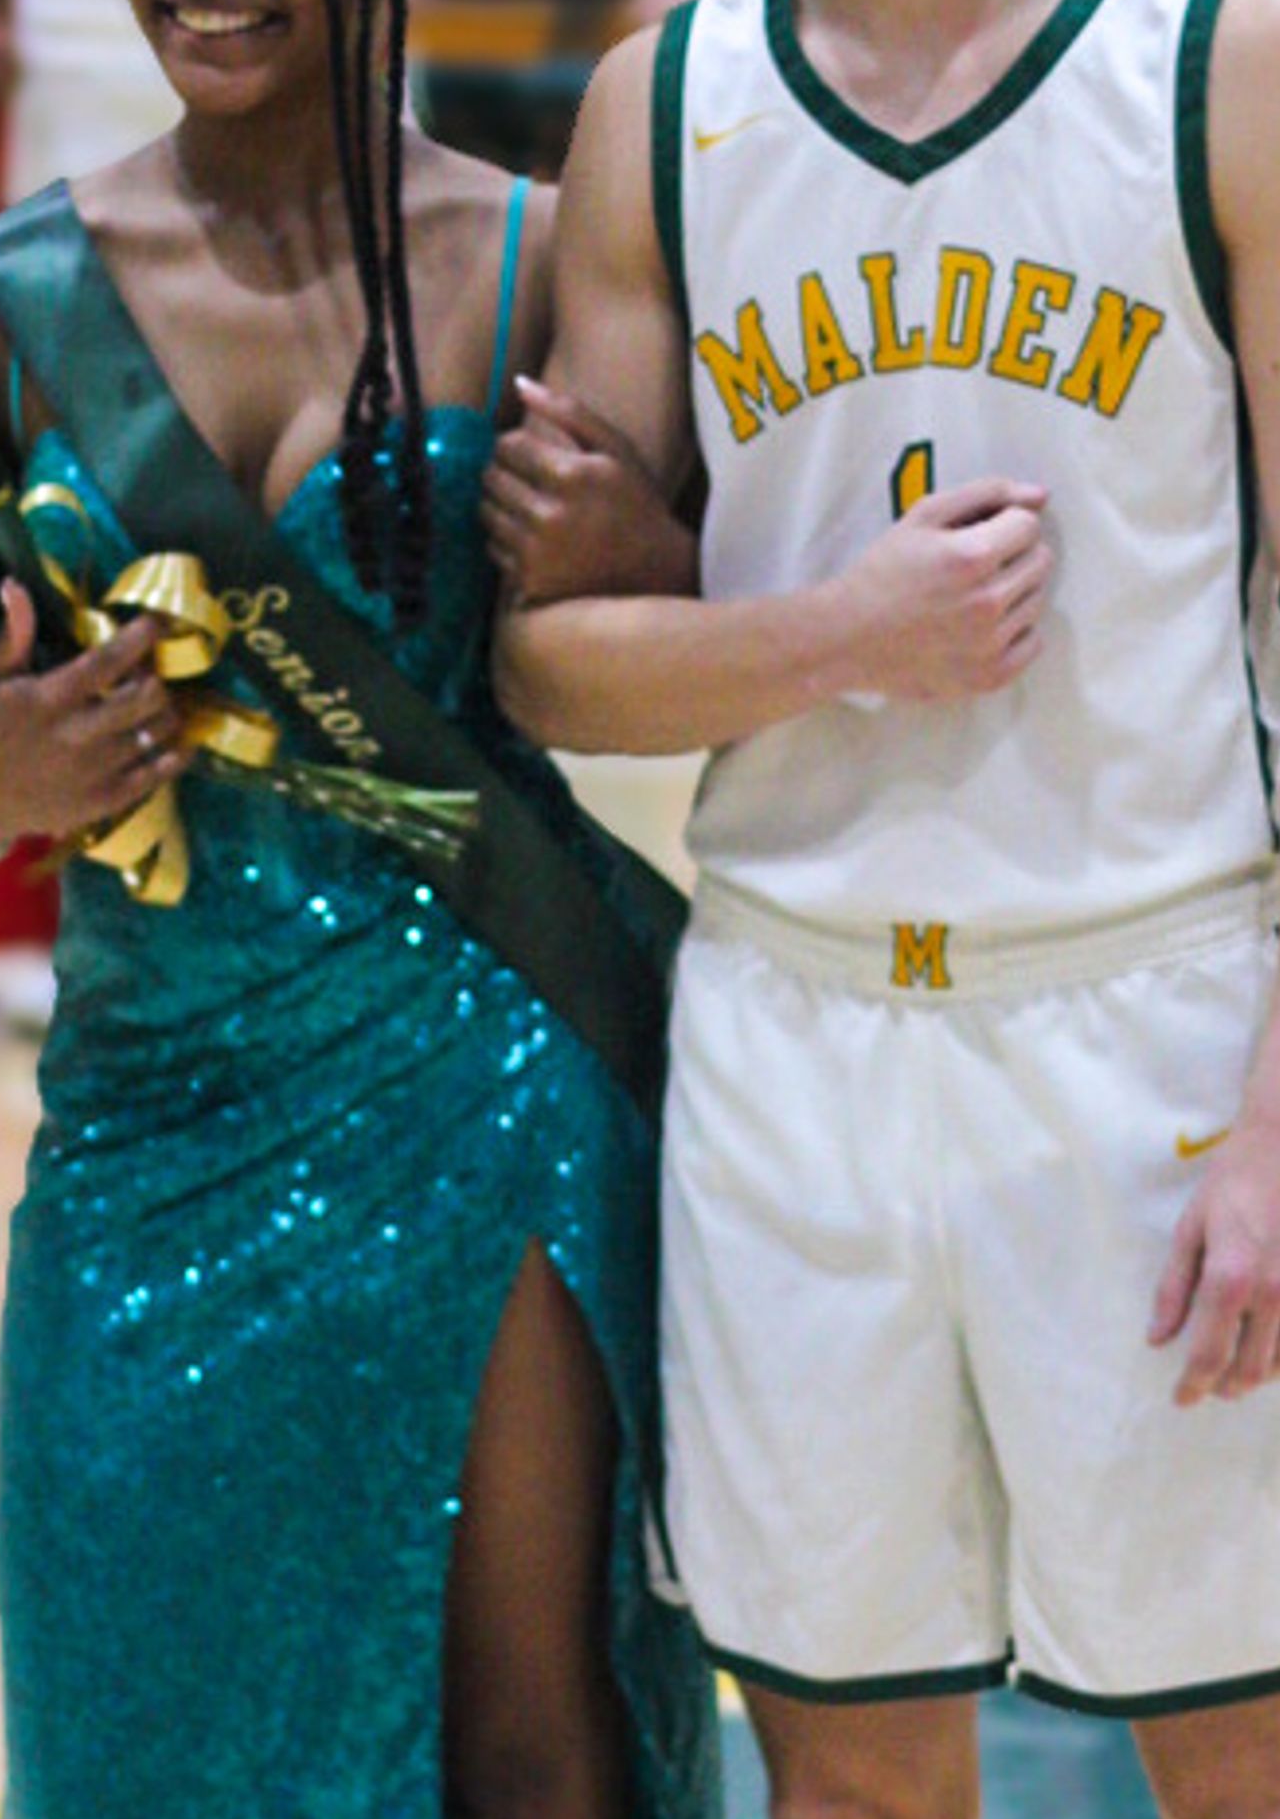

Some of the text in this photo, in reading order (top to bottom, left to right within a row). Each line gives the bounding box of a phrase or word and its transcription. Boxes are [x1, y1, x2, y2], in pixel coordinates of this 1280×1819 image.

[696, 245, 1166, 443] MALDEN
[220, 586, 381, 761] Senior
[892, 920, 952, 990] M
